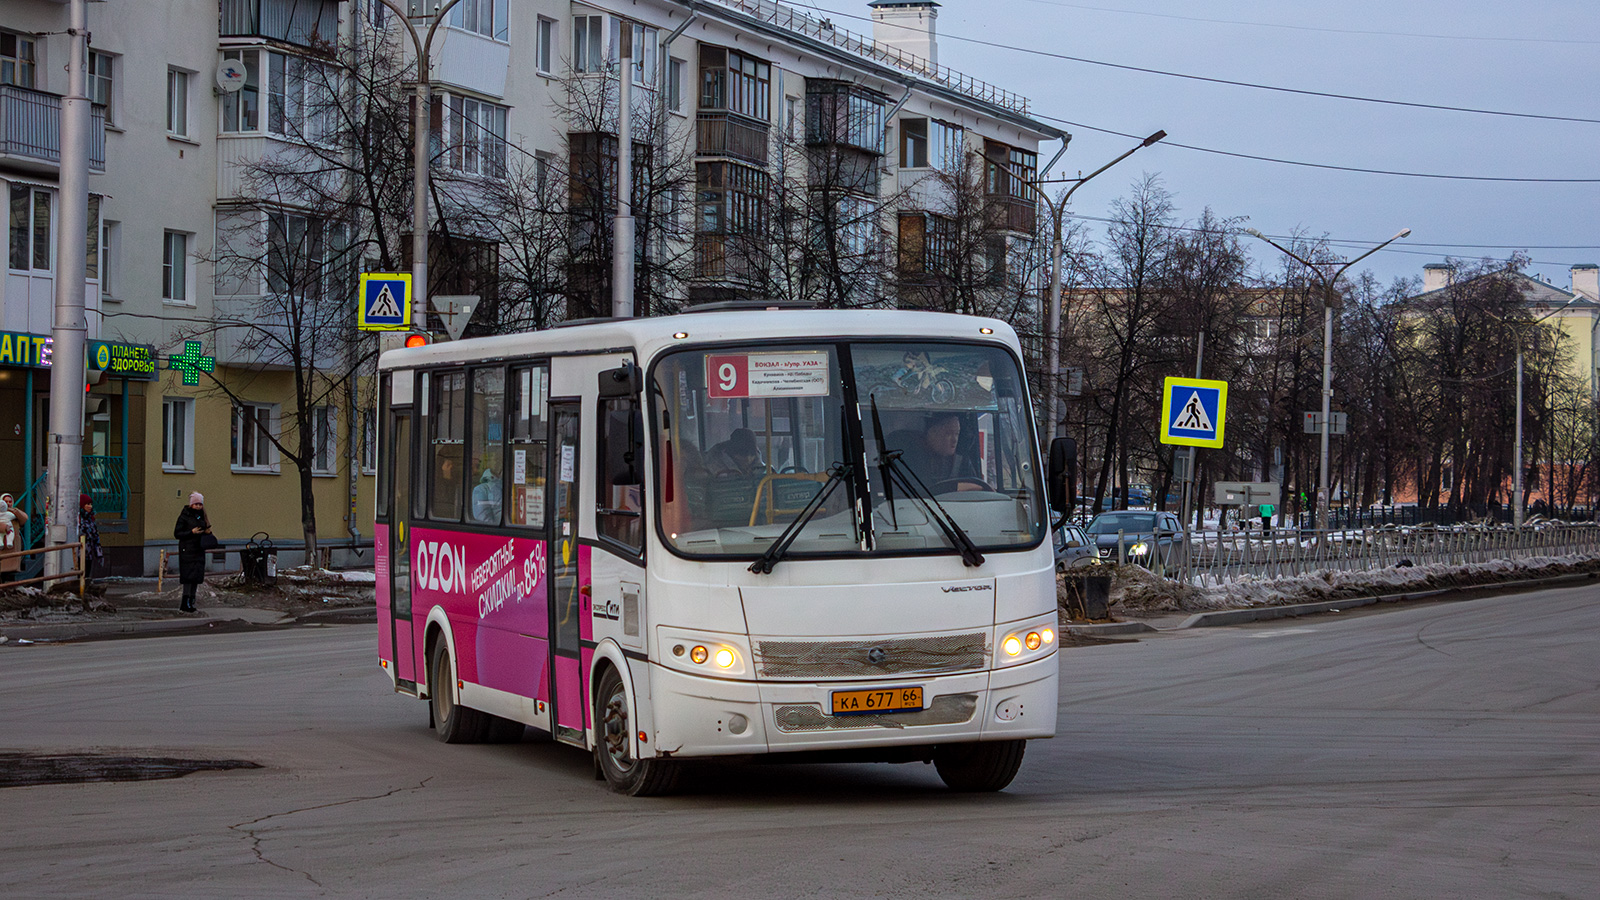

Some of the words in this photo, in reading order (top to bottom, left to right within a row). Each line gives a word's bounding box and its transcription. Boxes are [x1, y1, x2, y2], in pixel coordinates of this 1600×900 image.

[111, 357, 155, 373] ЗДОРОВЬЯ
[112, 345, 149, 360] ПЛАНЕТА
[718, 363, 737, 391] 9
[417, 540, 466, 595] OZON
[471, 538, 514, 593] НЕВЕРОЯТНЫЕ
[524, 540, 546, 595] 85%
[479, 567, 516, 619] СКИДКИ!
[866, 692, 893, 708] 677
[903, 690, 917, 701] 66
